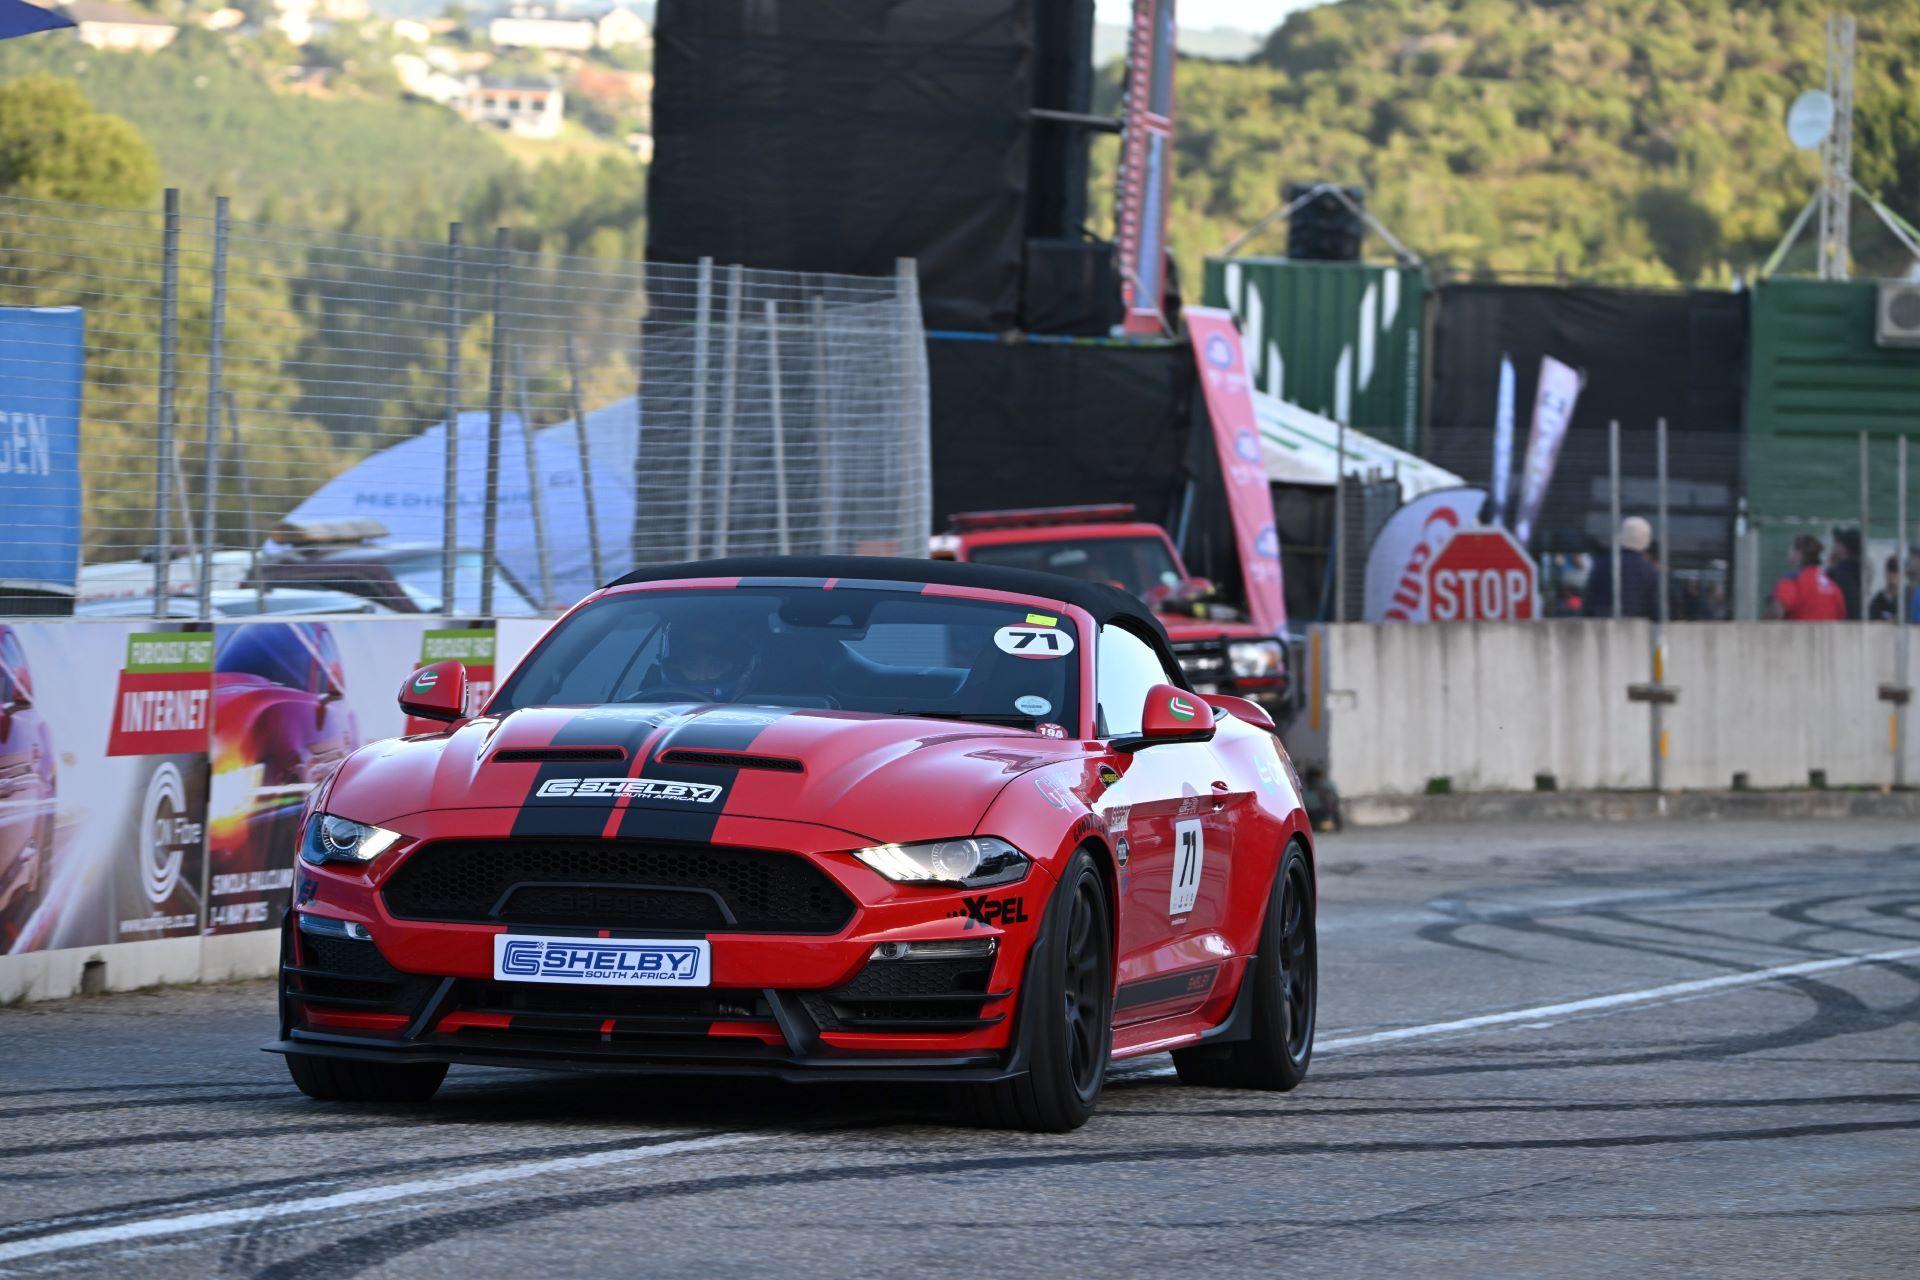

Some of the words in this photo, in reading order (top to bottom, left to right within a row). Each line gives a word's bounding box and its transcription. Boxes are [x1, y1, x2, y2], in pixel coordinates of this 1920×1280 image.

[1434, 568, 1528, 619] STOP
[1008, 631, 1059, 651] 71
[120, 689, 209, 733] INTERNET
[576, 781, 712, 798] SHELBY
[612, 791, 651, 800] SOUTH
[652, 794, 696, 802] AFRICA
[1179, 830, 1197, 888] 71
[961, 895, 1029, 929] XPEL
[543, 949, 692, 972] SHELBY
[584, 970, 627, 979] SOUTH
[630, 971, 677, 980] AFRICA
